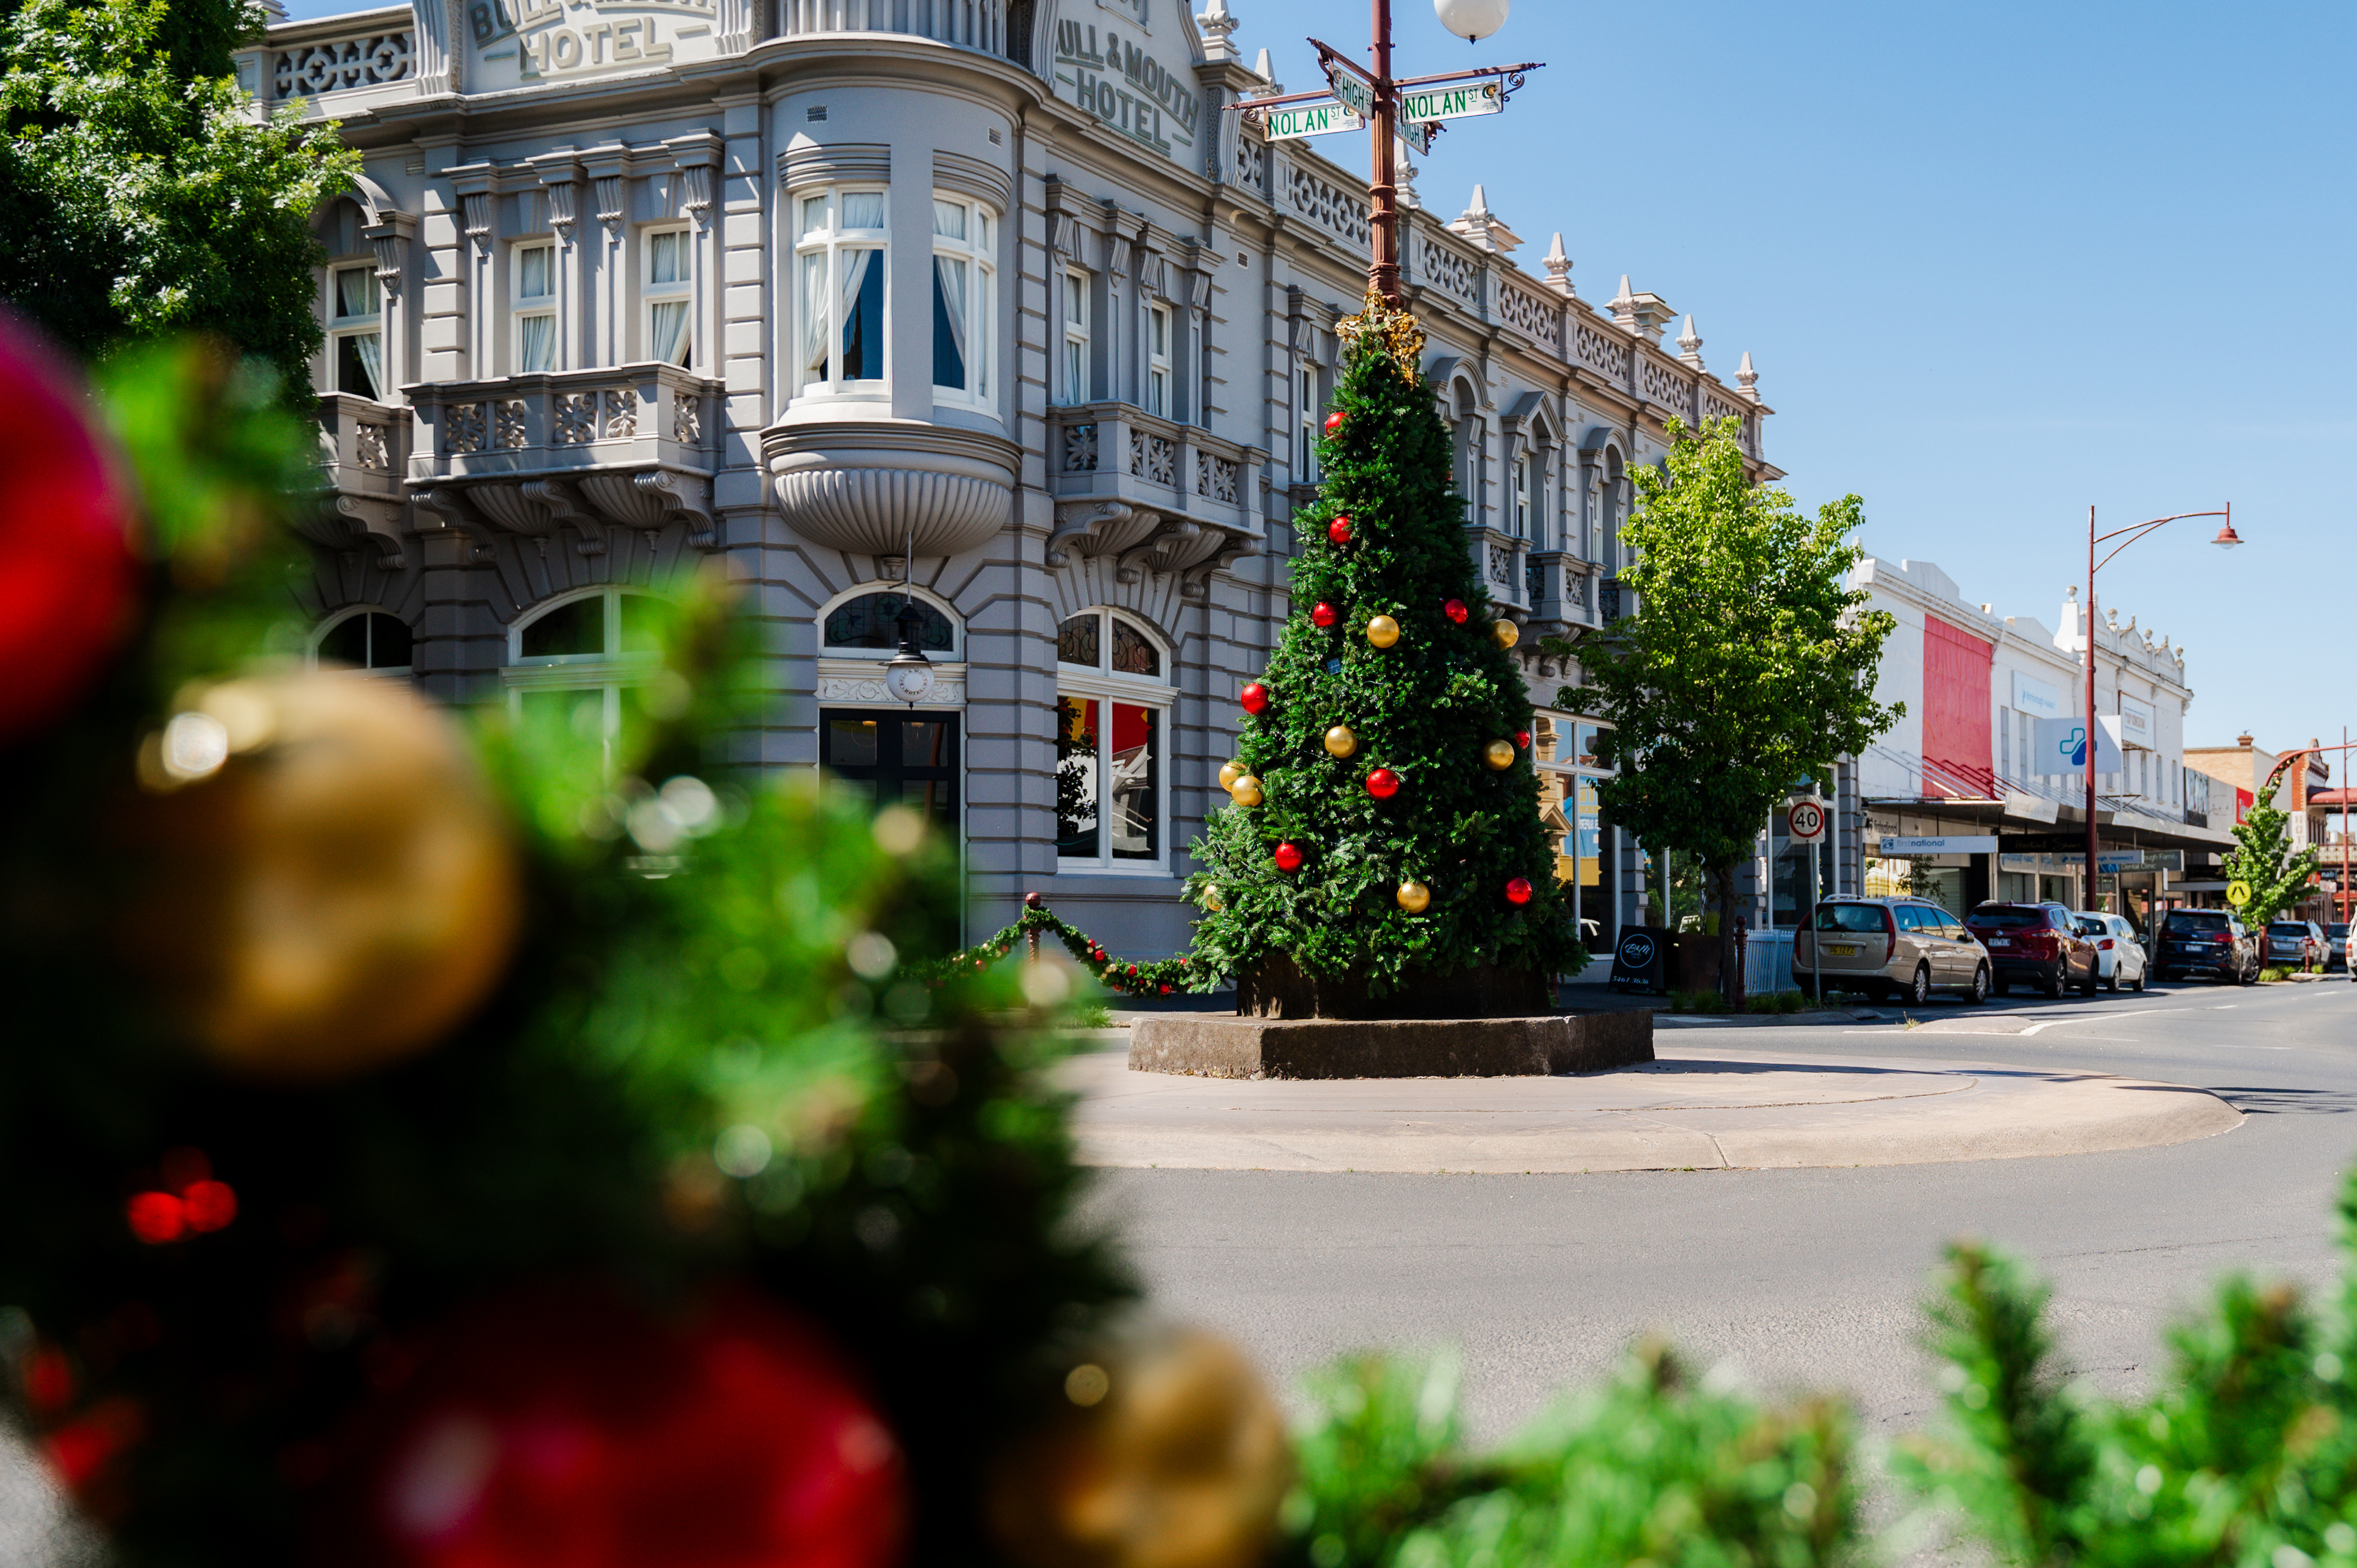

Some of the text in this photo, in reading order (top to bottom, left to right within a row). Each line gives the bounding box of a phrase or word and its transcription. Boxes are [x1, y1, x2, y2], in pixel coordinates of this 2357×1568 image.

[520, 16, 672, 73] HOTEL
[1056, 19, 1199, 131] ULL & MOUTH
[1077, 68, 1171, 150] HOTEL
[1342, 76, 1365, 110] HIGH
[1366, 91, 1372, 103] ST
[1405, 90, 1466, 120] NOLAN
[1469, 88, 1479, 100] ST
[1269, 109, 1328, 137] NOLAN
[1331, 106, 1341, 118] ST
[1401, 123, 1420, 146] HIGH
[1794, 811, 1818, 827] 40
